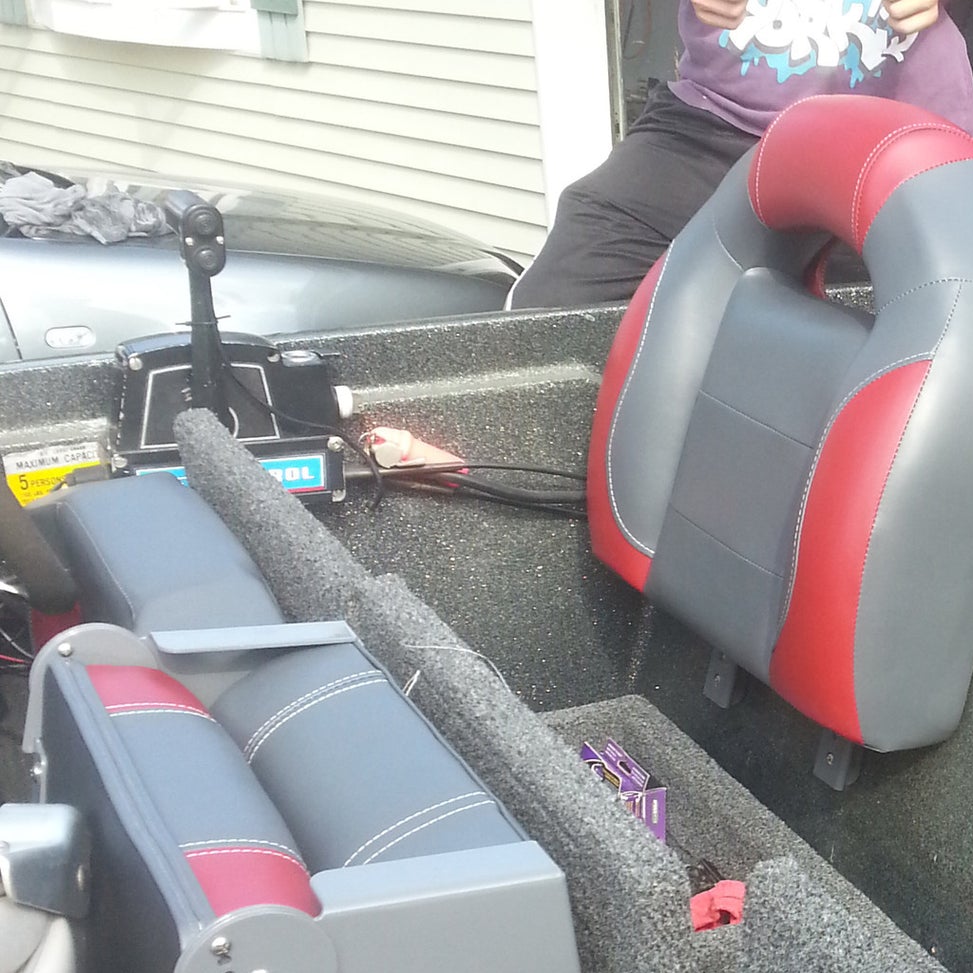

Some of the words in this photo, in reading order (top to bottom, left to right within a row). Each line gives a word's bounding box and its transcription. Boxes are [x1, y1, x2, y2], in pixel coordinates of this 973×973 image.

[16, 456, 59, 470] MAXIMUM
[19, 474, 29, 490] 5
[268, 466, 315, 482] ROL
